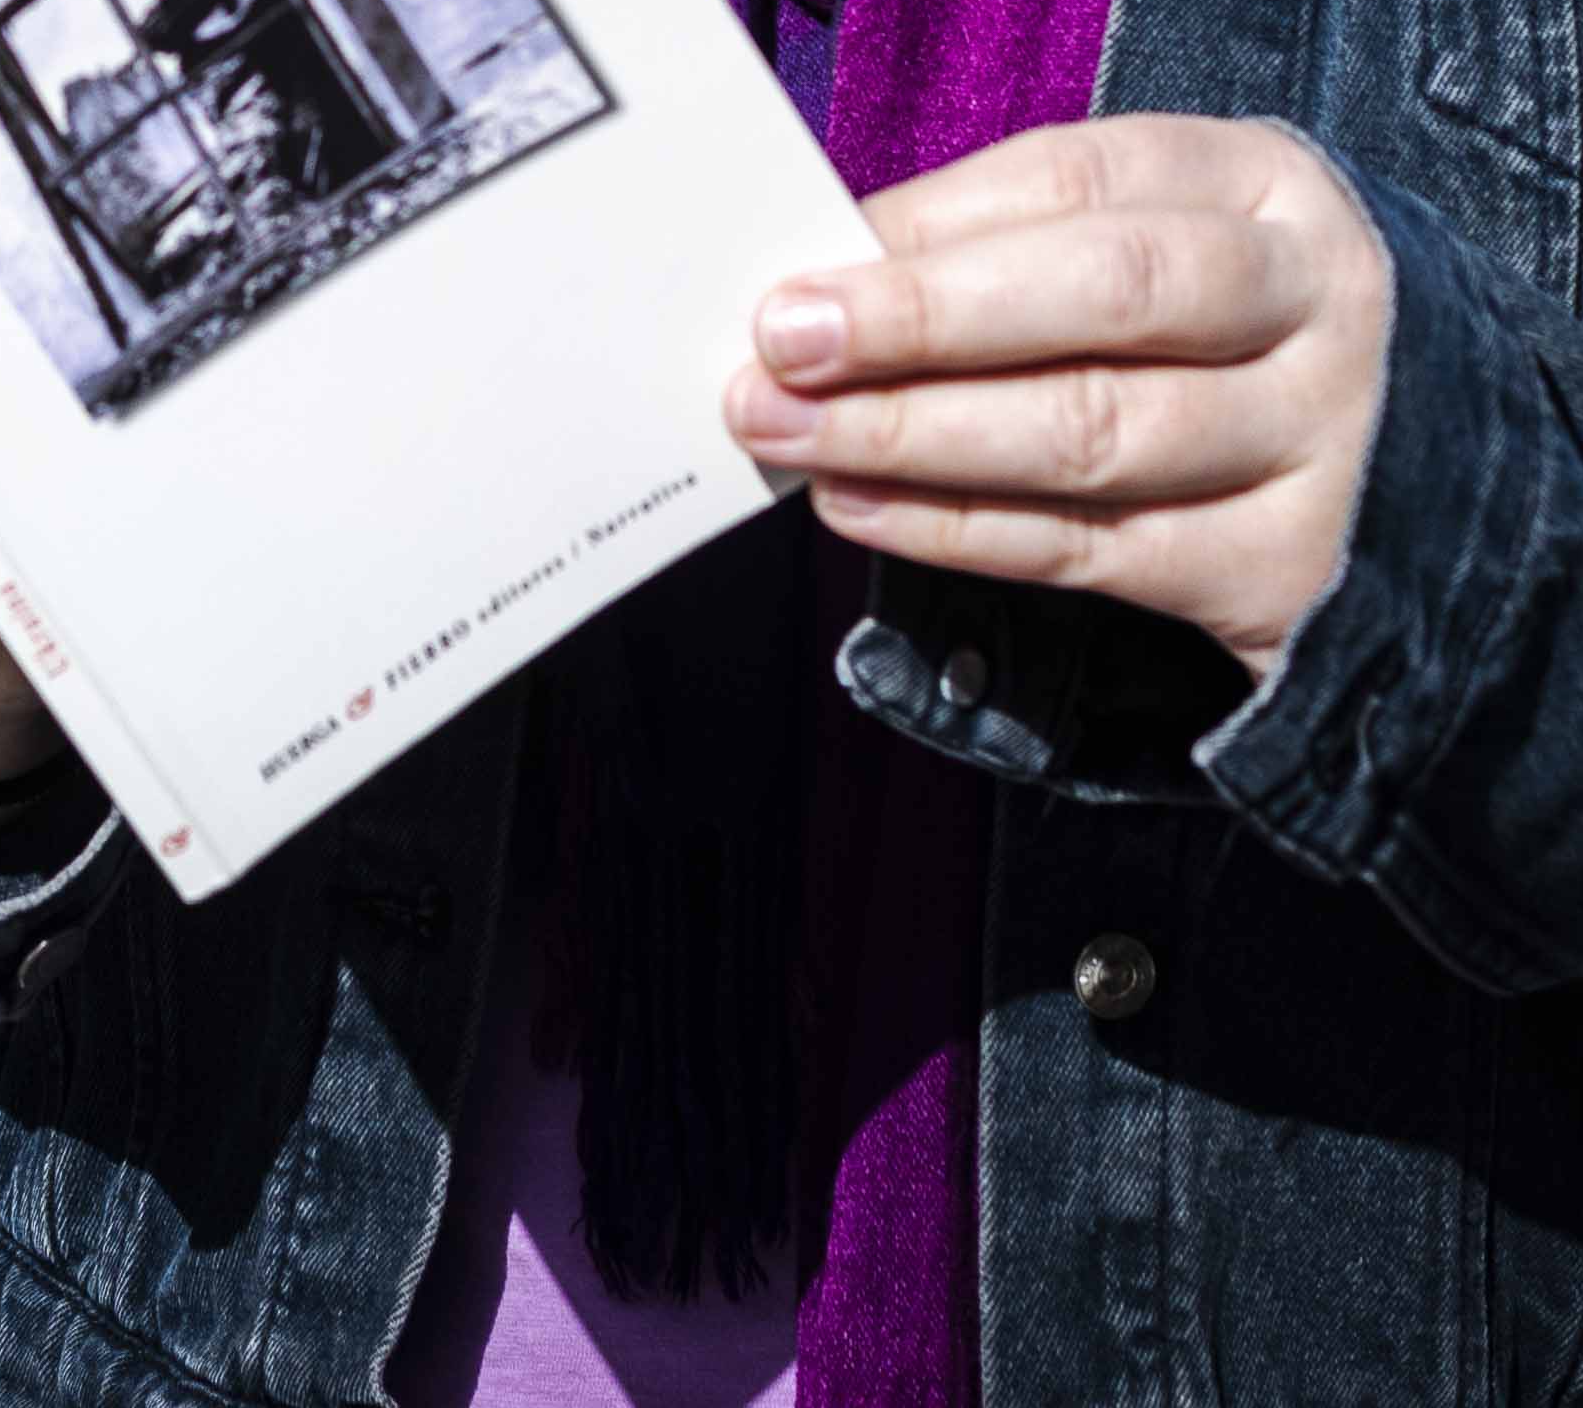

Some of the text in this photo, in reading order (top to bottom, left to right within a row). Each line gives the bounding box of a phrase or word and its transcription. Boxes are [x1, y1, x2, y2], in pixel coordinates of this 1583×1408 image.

[384, 618, 472, 692] FIERRO
[476, 555, 566, 625] editores
[585, 471, 699, 548] Narrativa
